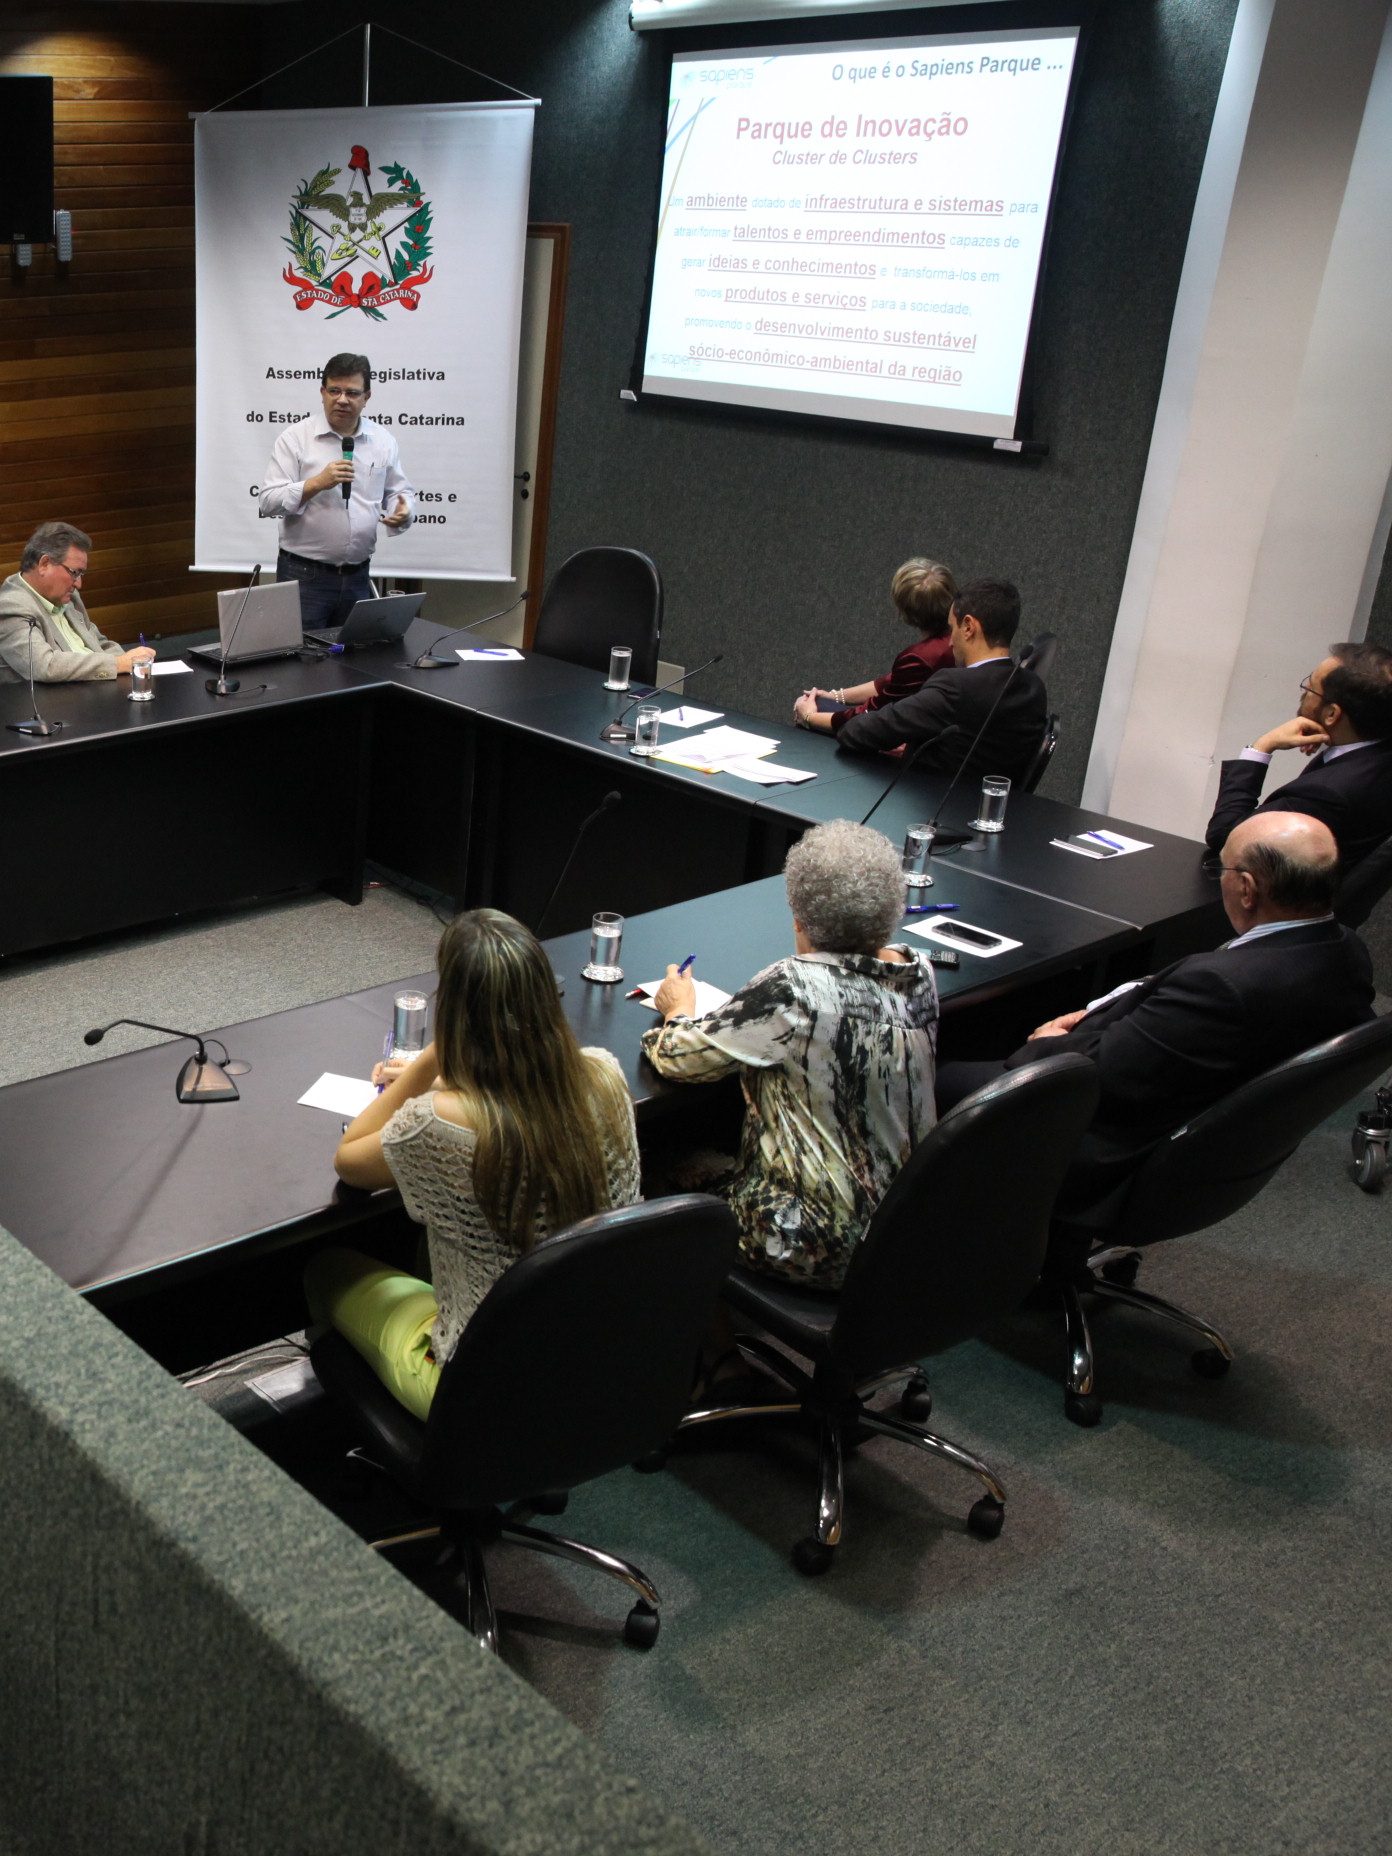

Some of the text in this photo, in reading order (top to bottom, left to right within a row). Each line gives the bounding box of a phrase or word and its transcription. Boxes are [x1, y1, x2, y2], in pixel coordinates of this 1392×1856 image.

[832, 64, 844, 81] O
[847, 65, 878, 84] que
[881, 61, 891, 79] é
[895, 64, 905, 79] o
[910, 59, 974, 80] Sapiens
[979, 56, 1041, 75] Parque
[736, 112, 968, 144] Parque de Inovação
[772, 149, 917, 166] Cluster de Clusters
[686, 194, 747, 208] ambiente
[752, 197, 785, 208] dotado
[788, 197, 801, 209] de
[804, 194, 908, 211] infraestrutura
[914, 198, 923, 211] e
[928, 195, 1004, 213] sistemas
[1009, 201, 1038, 216] para
[733, 224, 789, 240] talentos
[793, 229, 802, 241] e
[806, 227, 946, 246] empreendimentos
[950, 235, 1000, 249] capazes
[1004, 234, 1019, 248] de
[681, 255, 999, 282] gerar ideias e conhecimentos e transformá-los em
[297, 290, 330, 301] ESTADO
[331, 296, 342, 305] DE
[380, 291, 417, 303] CATARINA
[694, 285, 972, 316] novos produtos e serviços para a sociedade,
[685, 316, 977, 349] promovendo o desenvolvimento sustentável
[371, 368, 445, 382] egislativa
[688, 344, 963, 384] sócio-econômico-ambiental da região
[246, 411, 263, 422] do
[269, 411, 310, 423] Estad
[398, 413, 465, 425] Catarina
[448, 493, 458, 502] e
